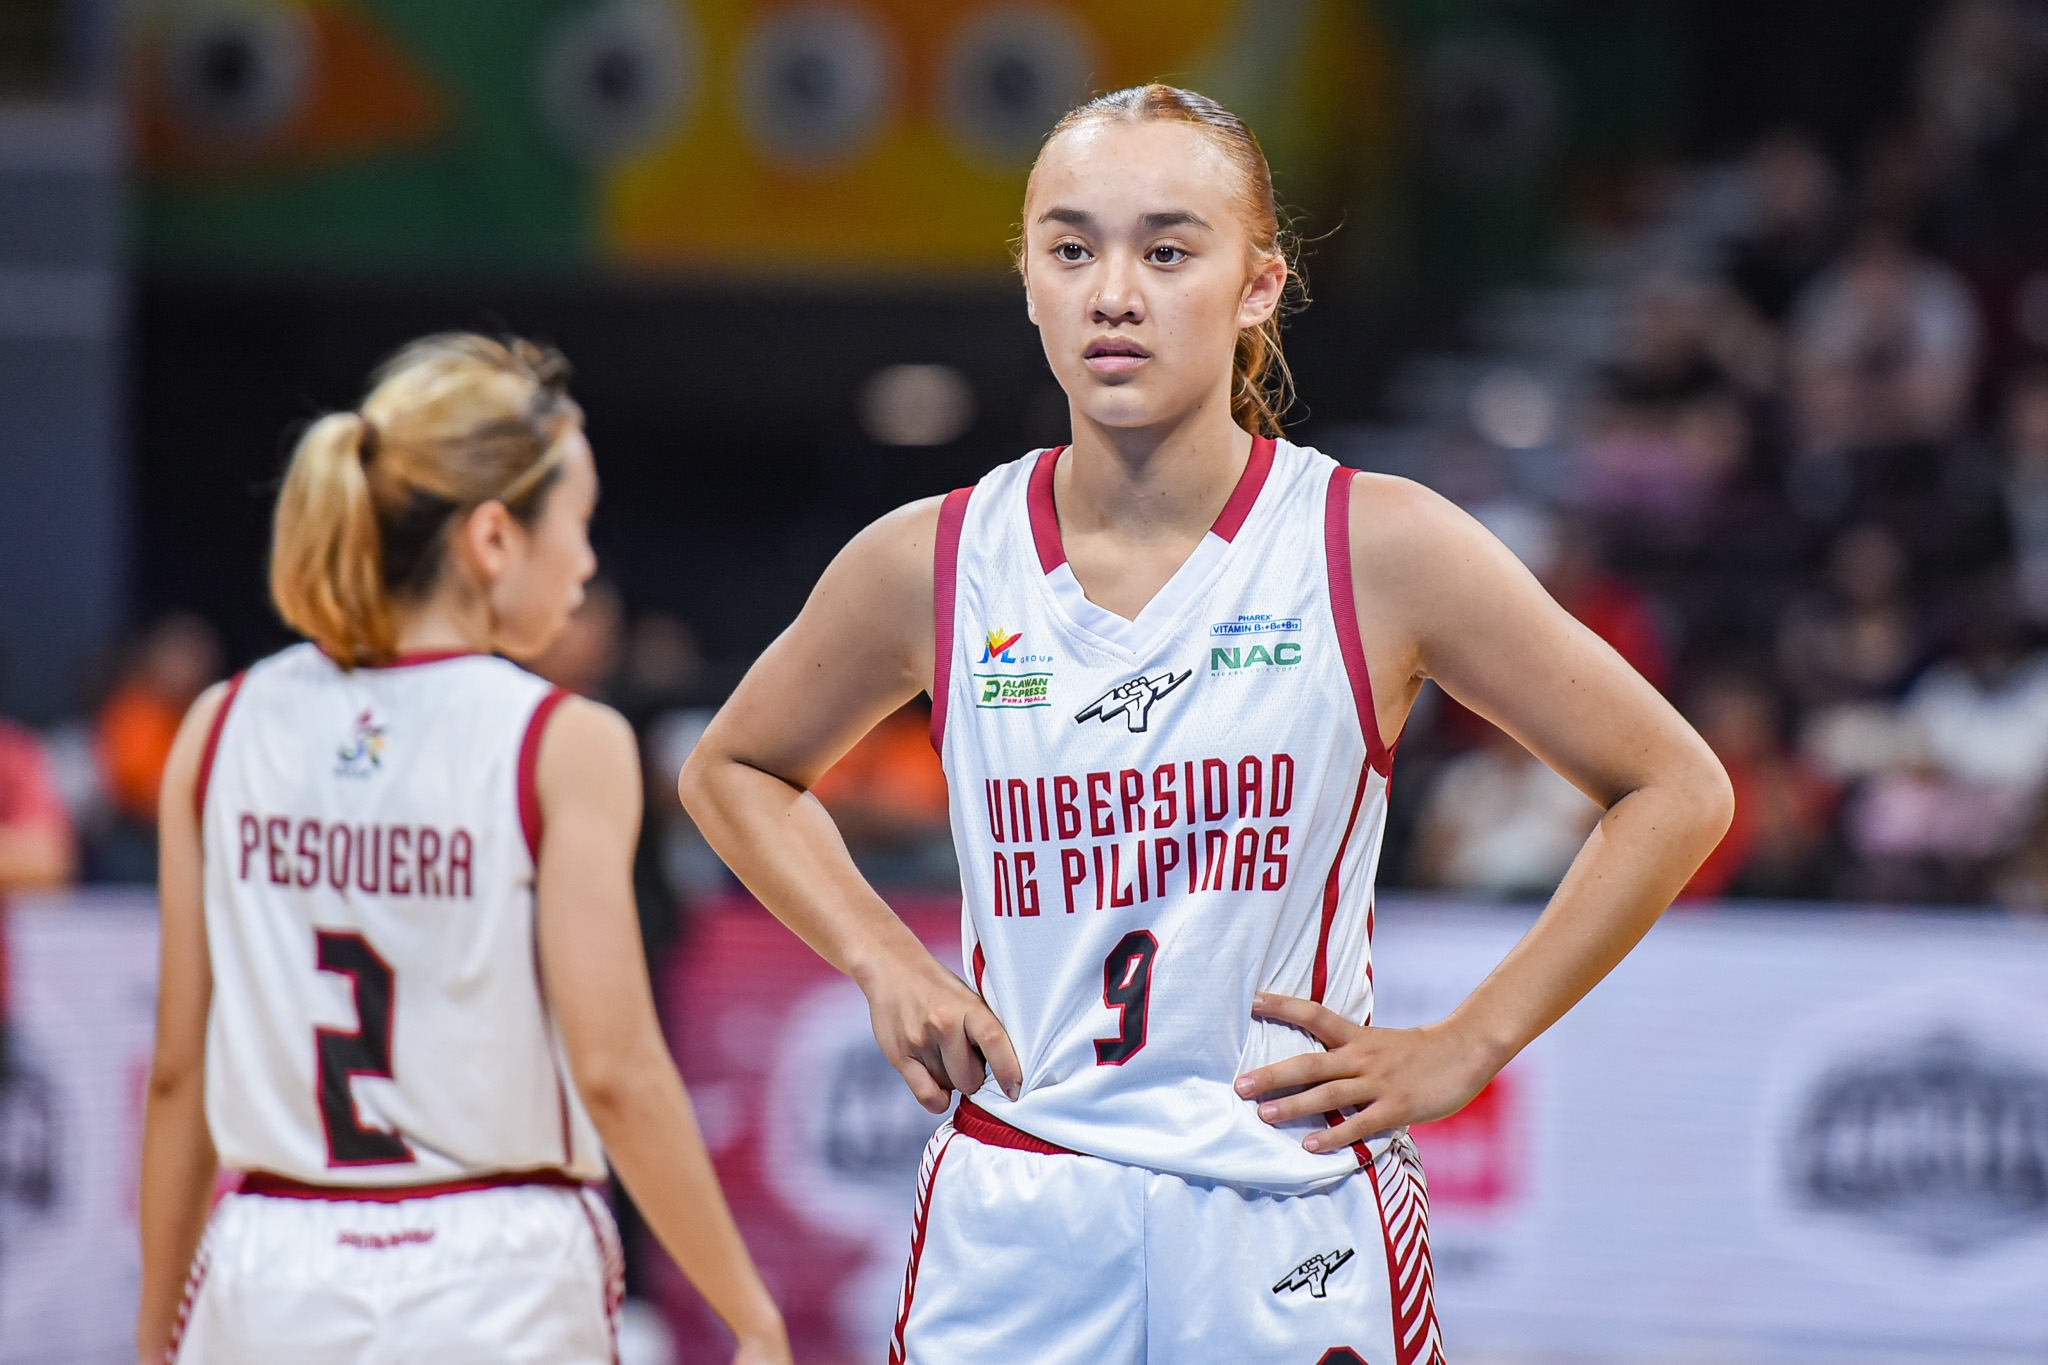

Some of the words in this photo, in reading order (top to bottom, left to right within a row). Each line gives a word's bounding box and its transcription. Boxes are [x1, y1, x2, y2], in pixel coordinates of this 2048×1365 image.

[1020, 654, 1053, 664] GROUP
[1210, 642, 1302, 671] NAC
[1213, 624, 1251, 634] VITAMIN
[1001, 687, 1048, 698] EXPRESS
[985, 753, 1295, 843] UNIBERSIDAD
[238, 811, 475, 904] PESQUERA
[994, 851, 1041, 918] NG
[1060, 825, 1290, 915] PILIPINAS
[1092, 929, 1160, 1067] 9
[313, 929, 417, 1168] 2
